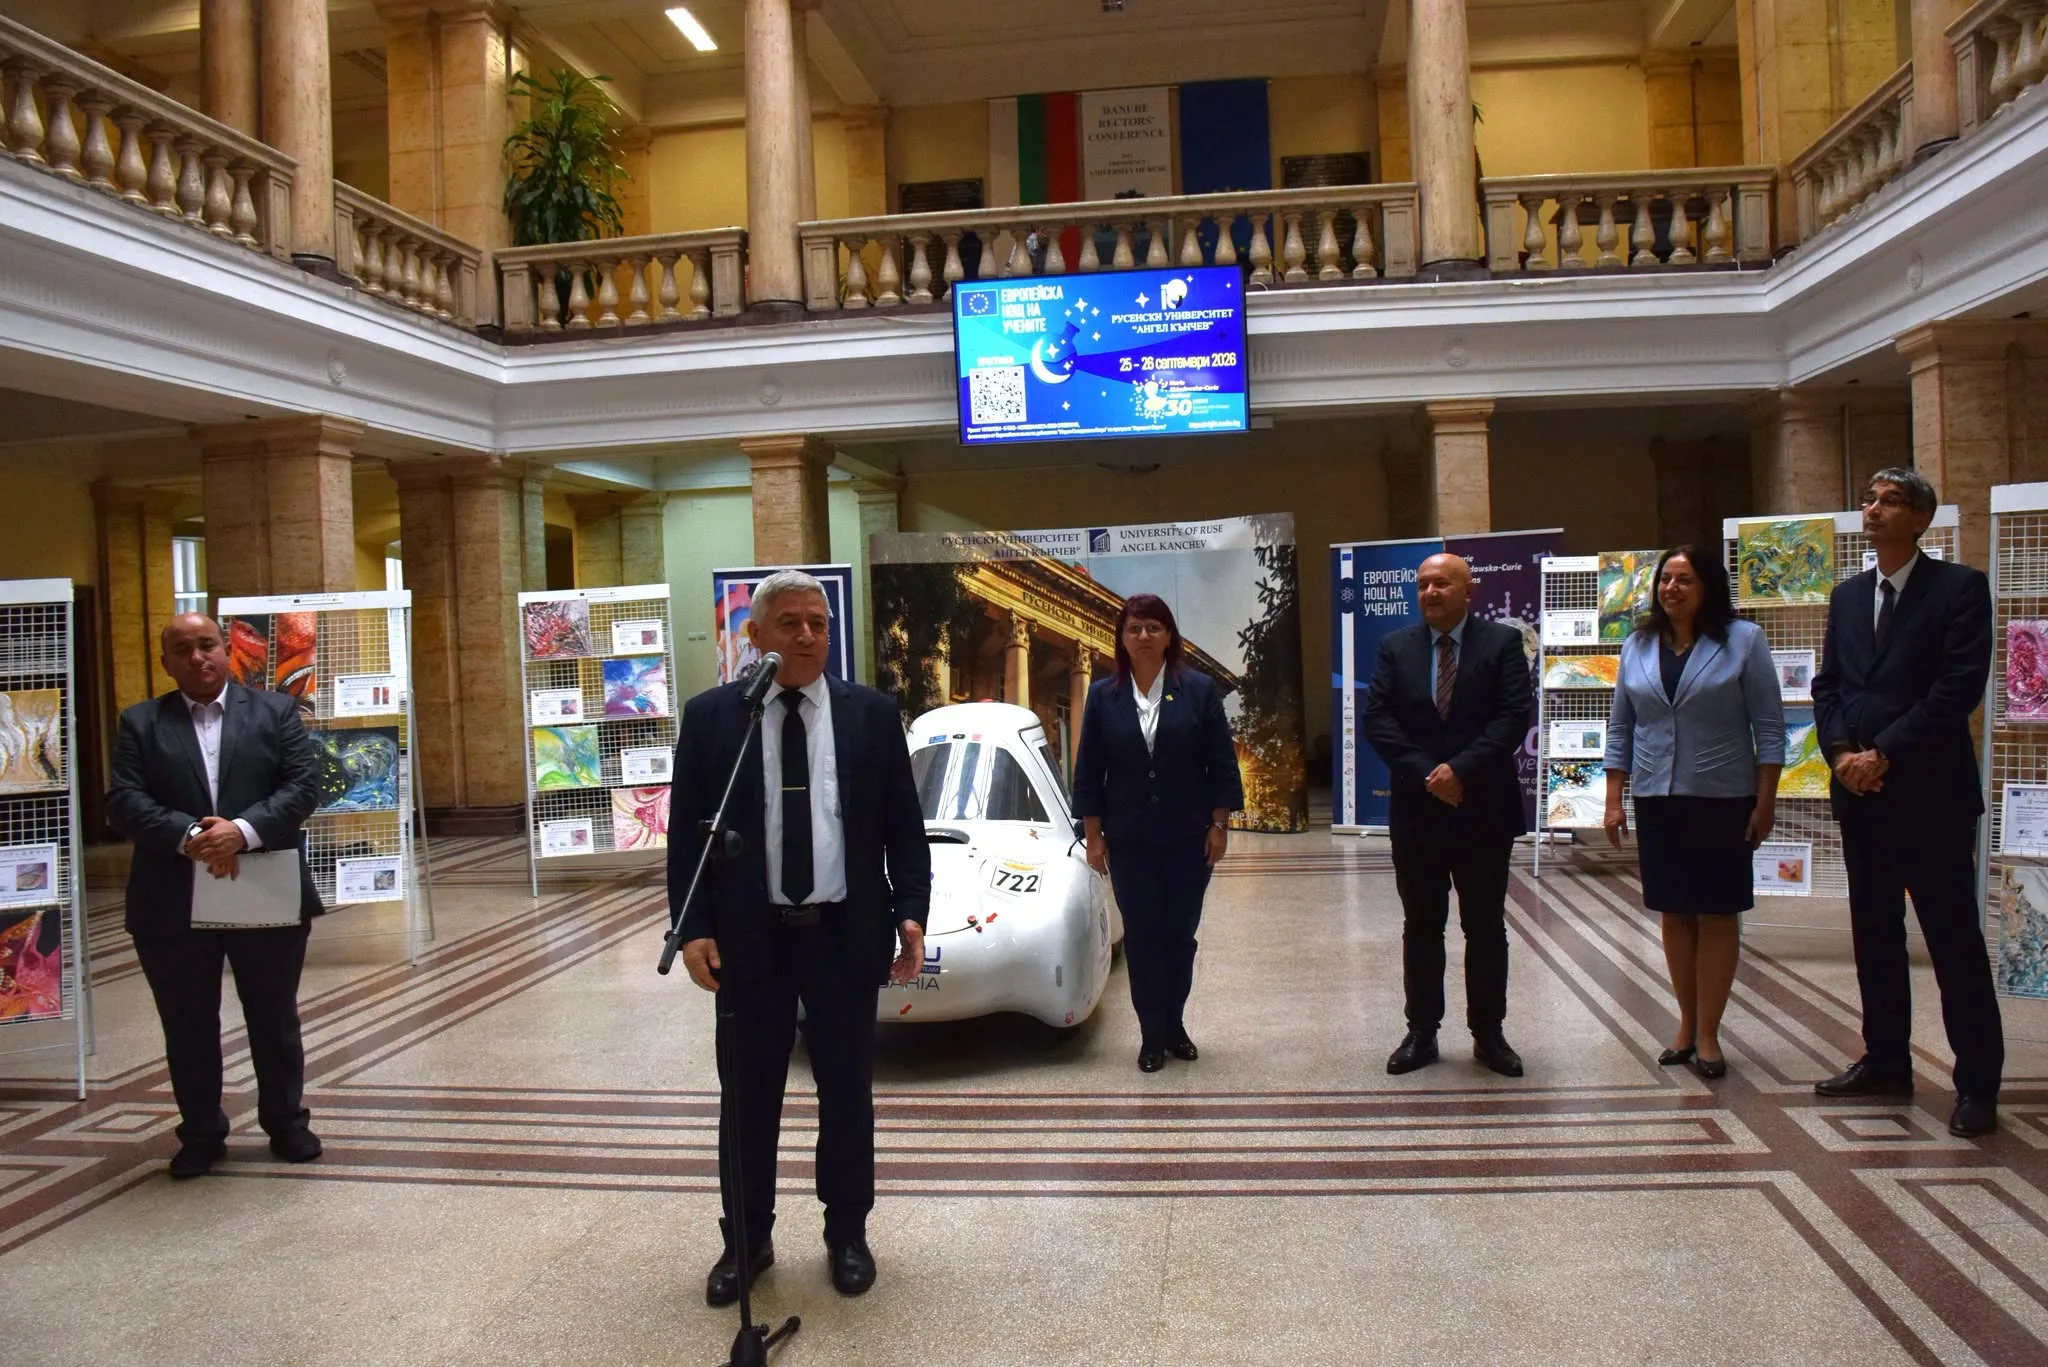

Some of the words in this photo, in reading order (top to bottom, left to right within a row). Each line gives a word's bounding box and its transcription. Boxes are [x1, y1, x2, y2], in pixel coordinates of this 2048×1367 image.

[1103, 104, 1149, 115] DANUBE
[1088, 128, 1166, 141] CONFERENCE
[1001, 285, 1064, 302] ЕВРОПЕЙСКА
[1002, 303, 1025, 318] НОЩ
[1027, 302, 1041, 317] НА
[1111, 312, 1163, 324] РУСЕНСКИ
[1164, 308, 1234, 321] УНИВЕРСИТЕТ
[1003, 318, 1047, 334] УЧЕНИТЕ
[1119, 357, 1133, 372] 25
[1141, 356, 1155, 371] 26
[1155, 355, 1210, 371] септември
[1211, 352, 1237, 368] 2026
[942, 535, 1000, 547] РУСЕНСКИ
[1001, 533, 1081, 545] УНИВЕРСИТЕТ
[1120, 527, 1184, 540] UNIVERSITY
[1184, 525, 1199, 536] OF
[1200, 524, 1224, 535] RUSE
[1120, 542, 1158, 553] ANGEL
[1160, 539, 1208, 551] KANCHEV
[1469, 562, 1523, 573] dowska-Curie
[1363, 567, 1417, 585] ЕВРОПЕЙС
[1363, 587, 1388, 601] НОЩ
[1390, 586, 1404, 600] НА
[1364, 601, 1409, 617] УЧЕНИТЕ
[996, 869, 1039, 893] 722
